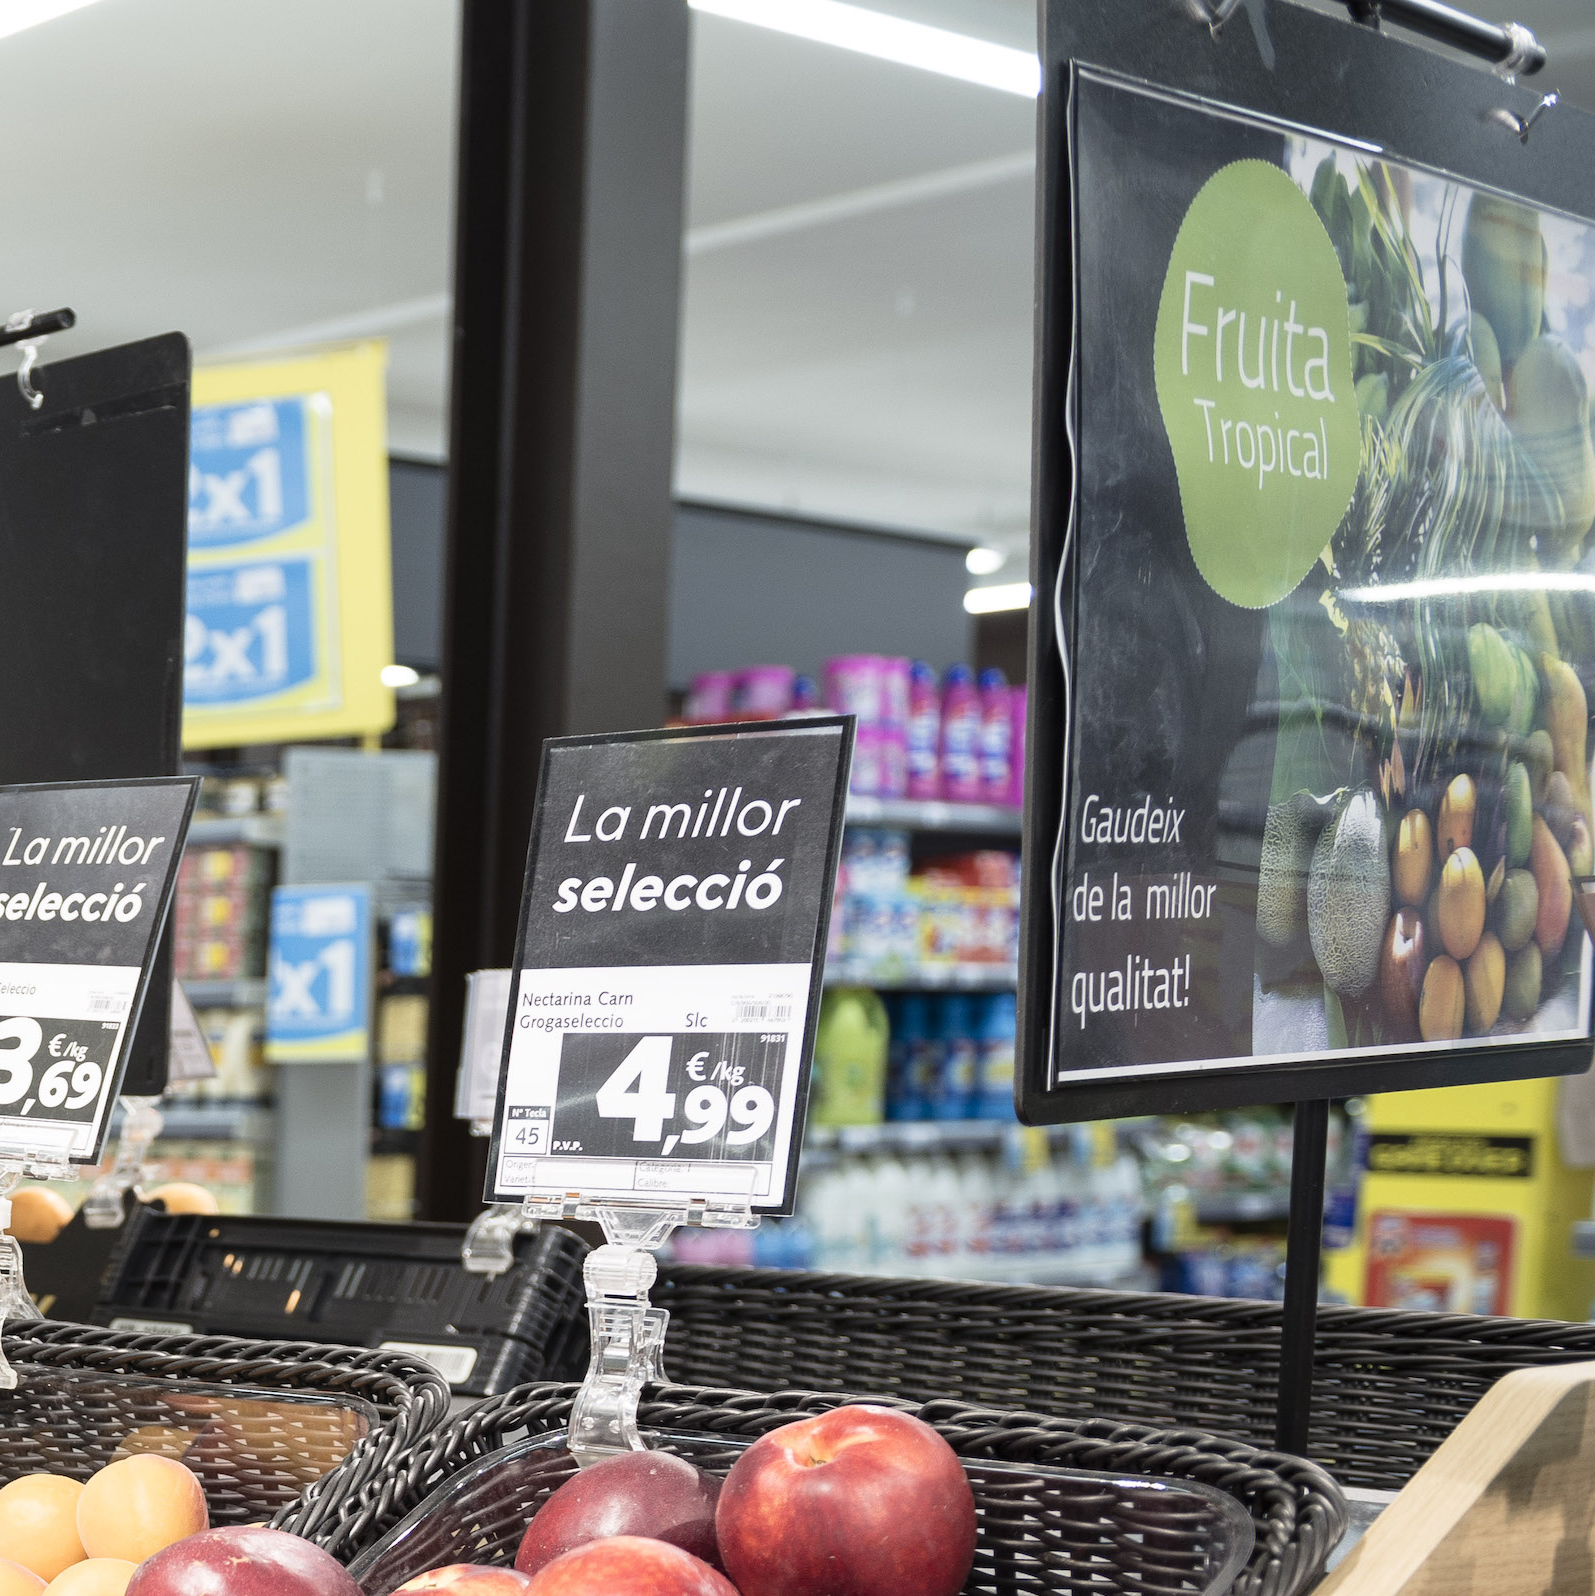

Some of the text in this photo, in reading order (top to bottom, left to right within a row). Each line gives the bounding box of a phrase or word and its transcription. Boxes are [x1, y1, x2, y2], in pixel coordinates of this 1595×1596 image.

[1181, 270, 1335, 403] Fruita
[1193, 397, 1328, 490] Tropical
[189, 446, 283, 526] x1
[564, 786, 802, 843] La millor
[1081, 794, 1186, 844] Gaudeix
[2, 825, 166, 866] La millor
[552, 858, 786, 913] selecció
[1072, 871, 1217, 922] de la millor
[270, 937, 357, 1020] x1
[522, 991, 634, 1008] Nectarina Carn
[1071, 953, 1191, 1030] qualitat!
[519, 1012, 625, 1033] Grogaseleccio
[685, 1012, 709, 1028] Slc
[760, 1033, 787, 1044] 91831
[525, 1108, 547, 1118] Tecla
[595, 1035, 775, 1156] 4,99
[515, 1127, 540, 1145] 45
